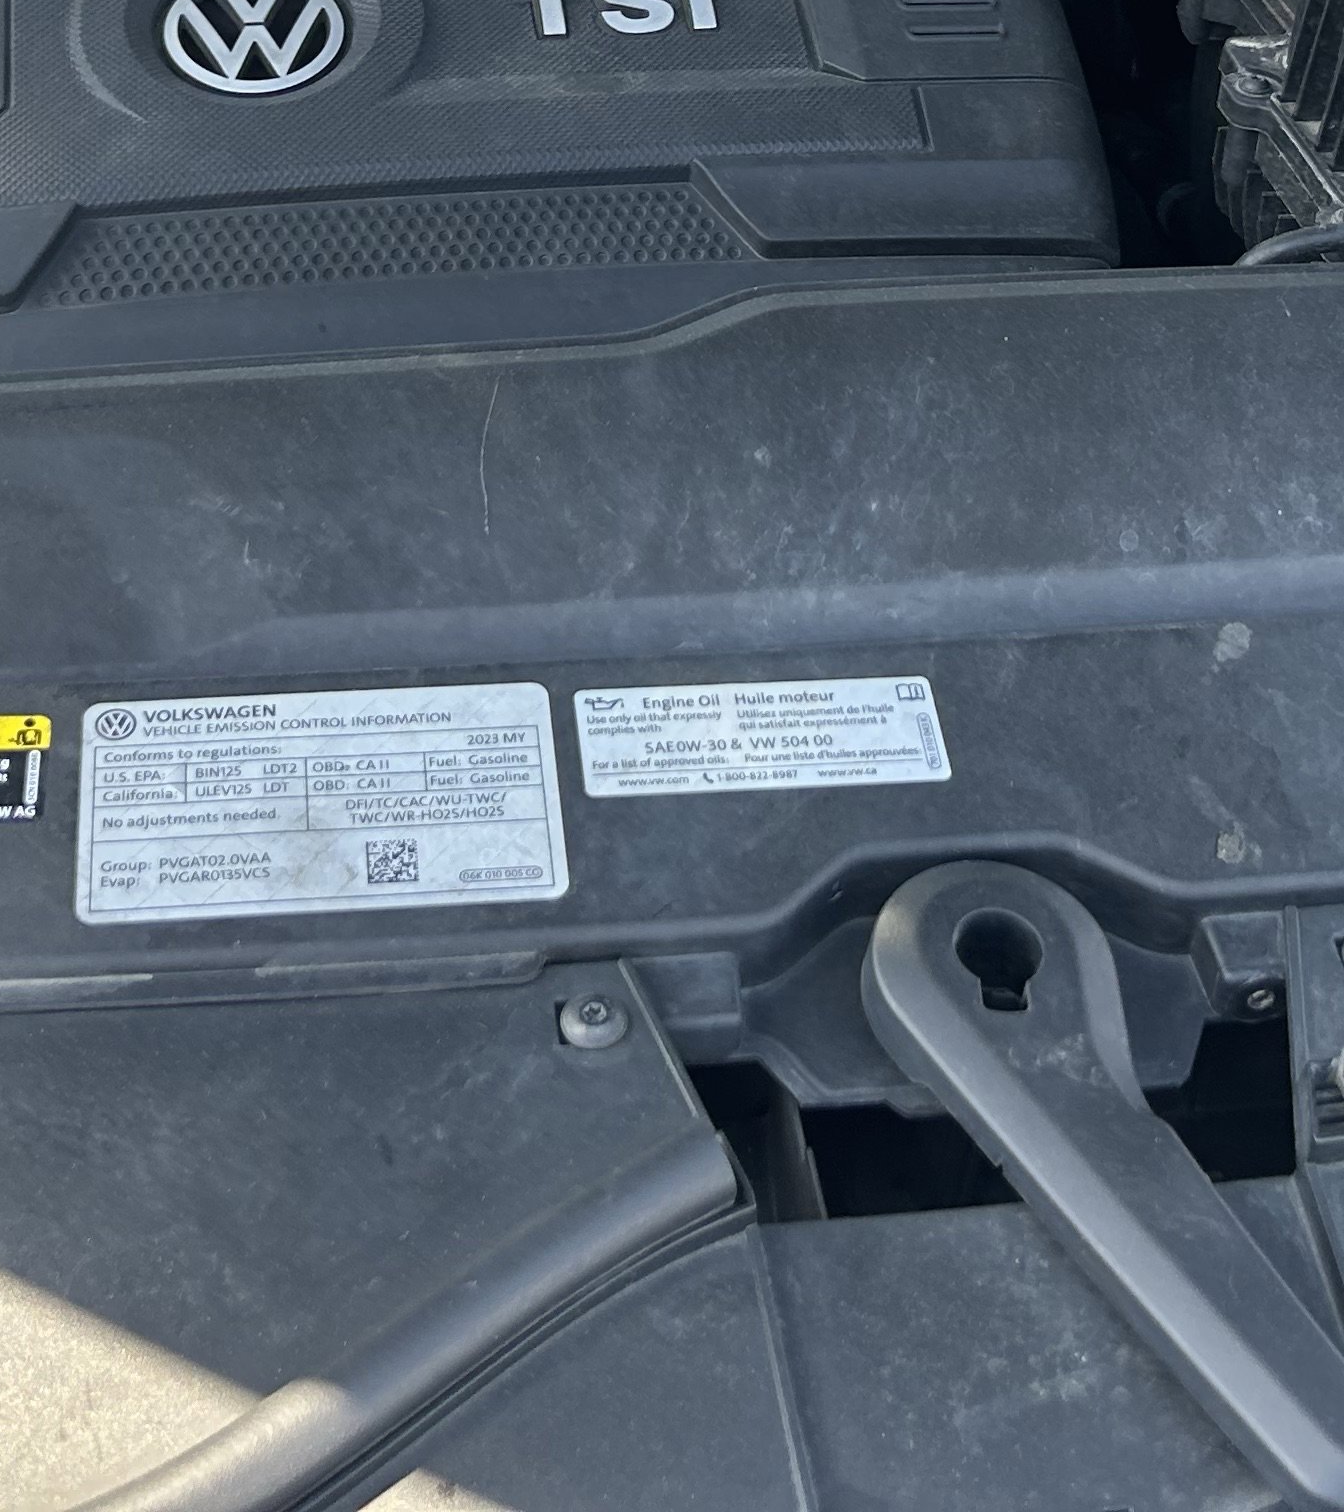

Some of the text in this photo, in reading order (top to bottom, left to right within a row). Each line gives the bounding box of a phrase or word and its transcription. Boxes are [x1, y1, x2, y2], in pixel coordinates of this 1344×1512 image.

[643, 694, 721, 711] Engine Oil
[734, 690, 834, 705] Huile moteur
[143, 703, 276, 723] VOLKSWAGEN
[586, 710, 722, 726] Use only oil that expressly
[779, 706, 845, 719] uniquement
[846, 705, 860, 715] de
[143, 711, 452, 738] VEHICLE EMISSION CONTROL INFORMATION
[587, 723, 662, 736] complies with
[739, 719, 756, 730] qui
[758, 718, 802, 729] satisfait
[466, 732, 526, 746] 2023 MY
[730, 738, 742, 750] &
[750, 736, 776, 749] VW
[781, 735, 809, 748] 504
[813, 733, 833, 746] 00
[104, 745, 282, 764] Conforms to regulations:
[428, 752, 528, 768] Fuel: Gasoline
[592, 759, 609, 769] For
[612, 760, 619, 769] a
[621, 758, 638, 768] list
[639, 757, 653, 767] of
[654, 755, 705, 769] approved
[744, 752, 769, 763] Pour
[771, 753, 792, 762] une
[793, 750, 815, 761] liste
[195, 763, 298, 779] BIN125 LDT2
[356, 759, 376, 771] CA
[817, 767, 878, 777] www.vw.ca
[104, 769, 166, 783] U.S. EPA:
[357, 777, 377, 790] CA
[429, 771, 530, 787] Fuel: Gasoline
[618, 777, 690, 787] www.vw.com
[103, 786, 178, 803] California:
[195, 781, 290, 798] ULEV125 LDT
[345, 792, 506, 811] DFI/TC/CAC/WU-TWC/
[13, 805, 36, 818] AG
[102, 807, 280, 829] No adjustments needed.
[350, 806, 505, 825] TWC/WR-HO2S/HO2S
[100, 851, 272, 874] Group: PVGAT02.0VAA
[100, 866, 271, 890] Evap: PVGAR0135VCS
